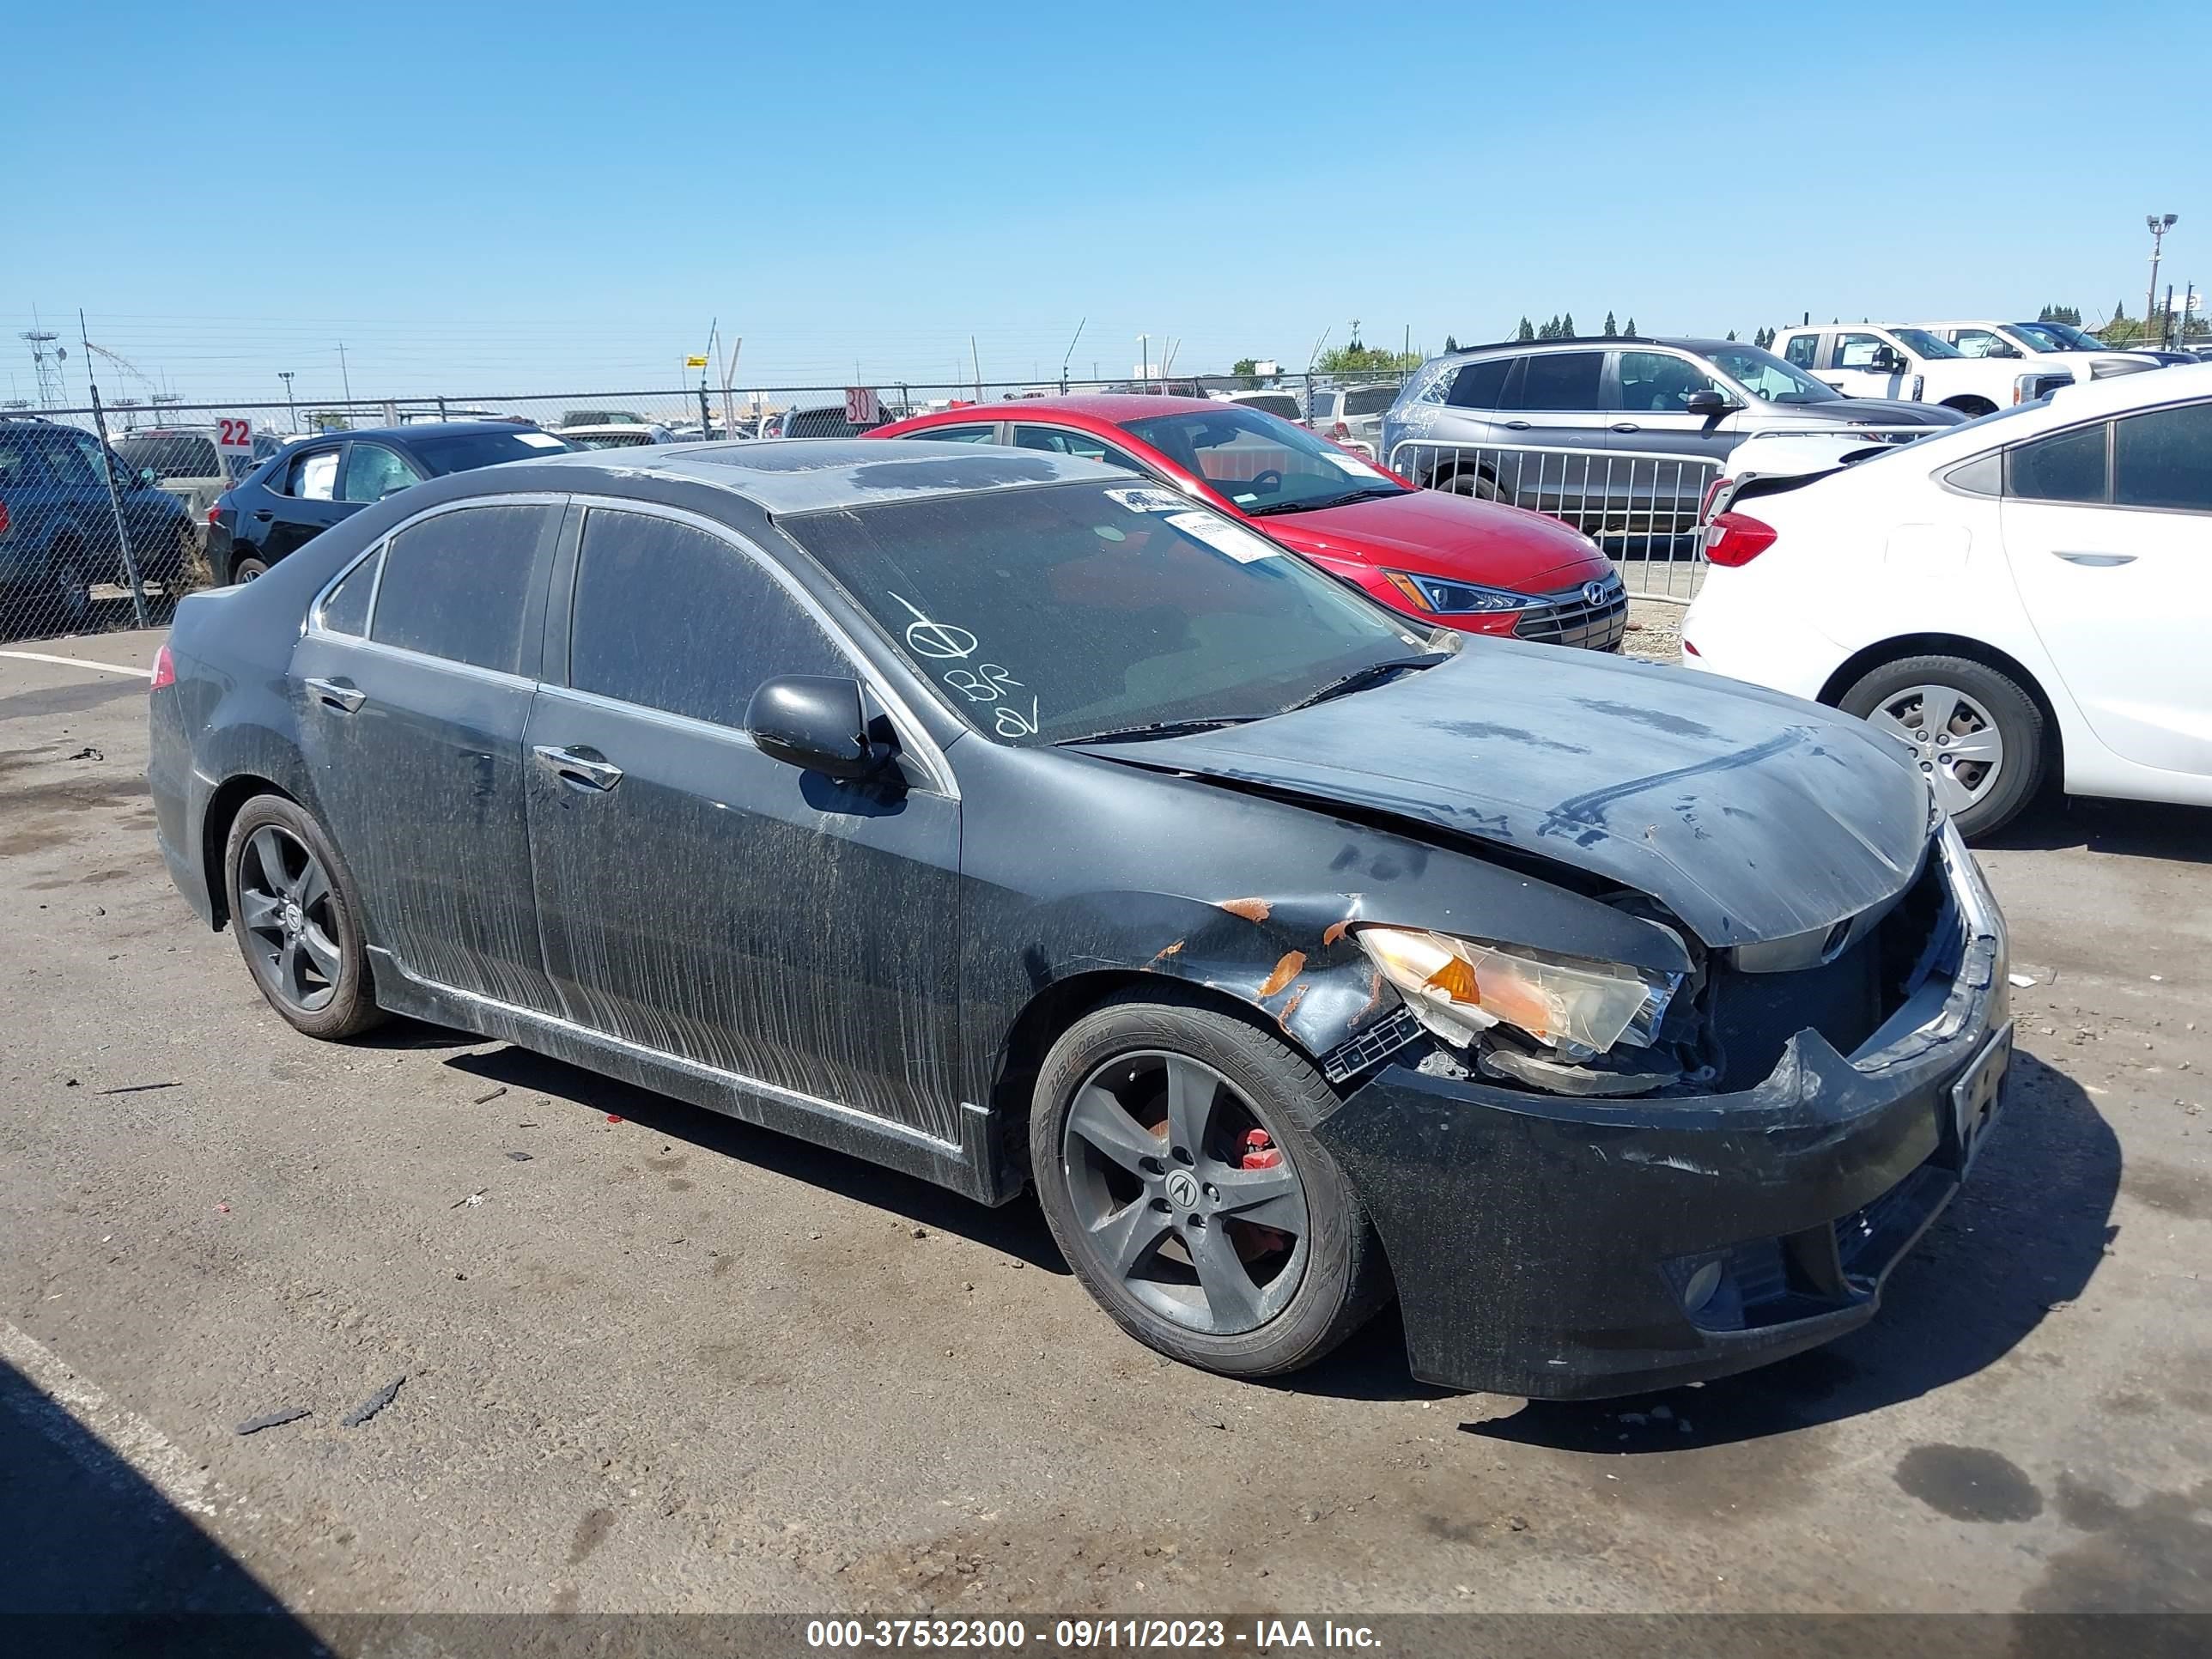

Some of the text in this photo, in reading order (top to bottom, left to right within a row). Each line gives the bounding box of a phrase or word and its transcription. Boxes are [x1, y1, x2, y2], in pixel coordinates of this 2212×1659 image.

[846, 388, 869, 422] 30
[219, 420, 251, 446] 22
[943, 663, 1025, 702] BR
